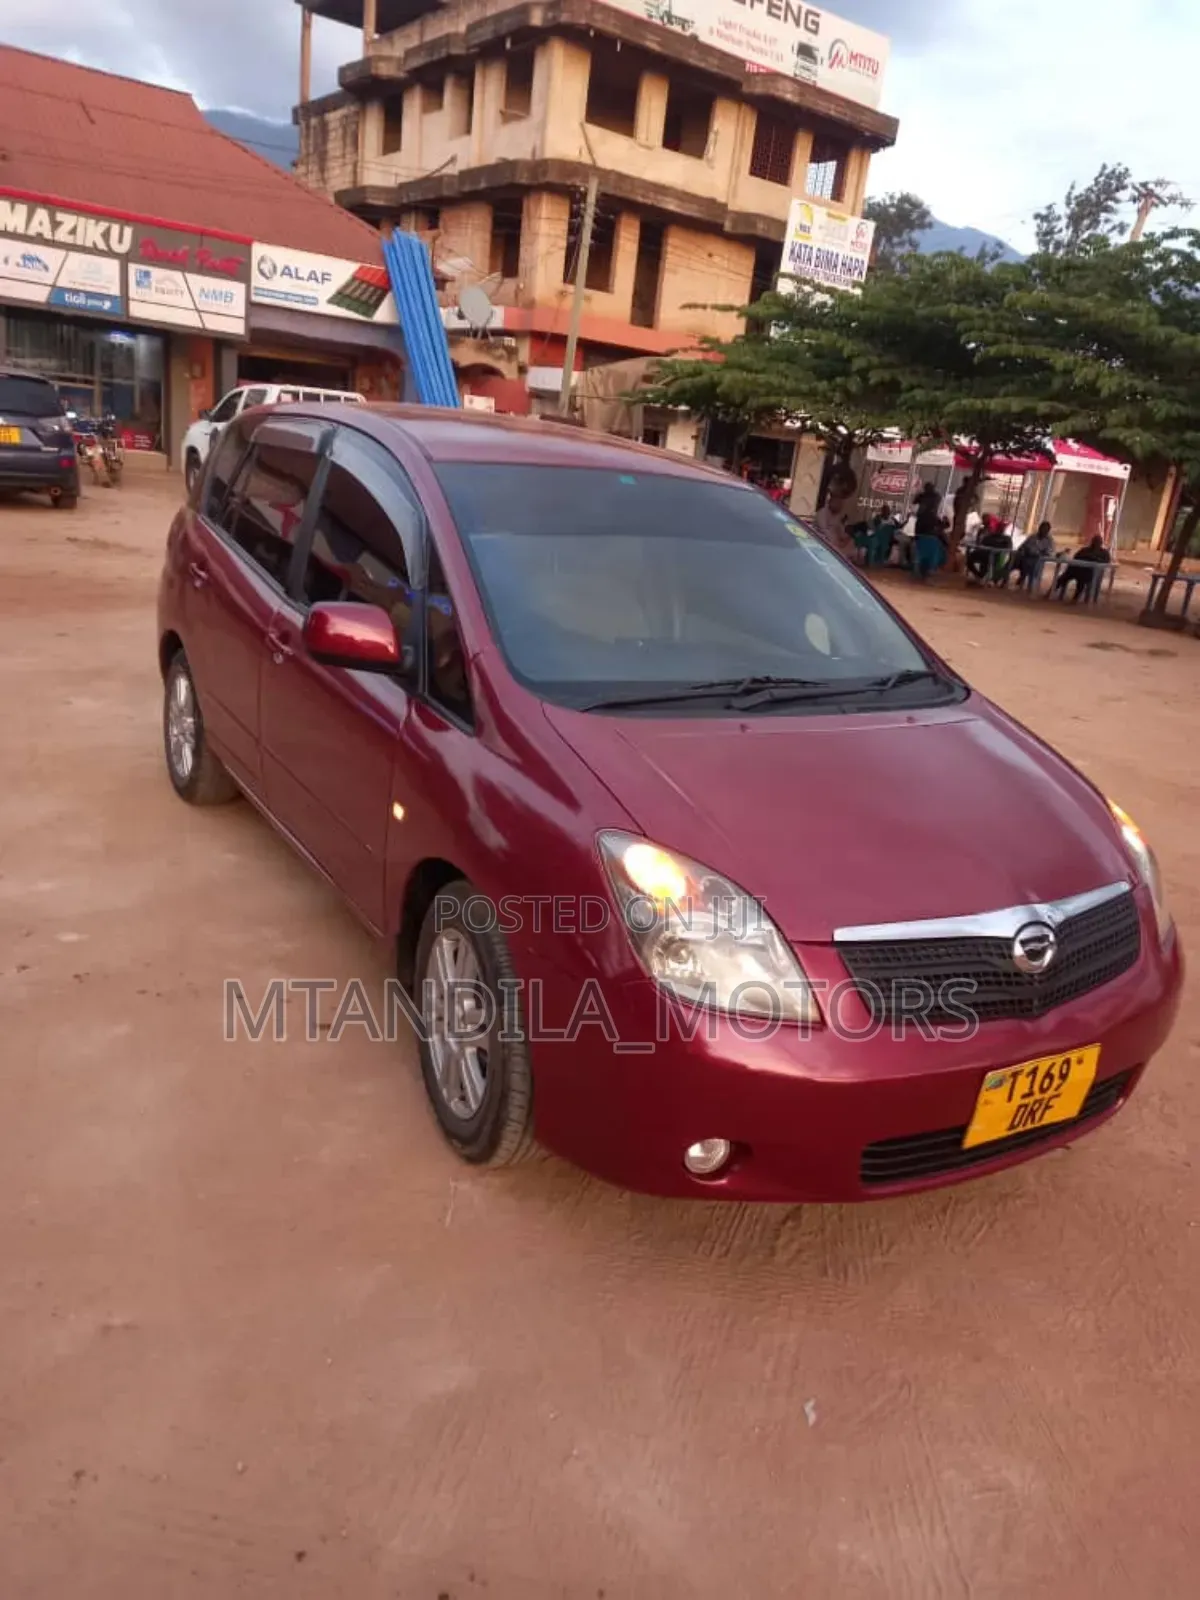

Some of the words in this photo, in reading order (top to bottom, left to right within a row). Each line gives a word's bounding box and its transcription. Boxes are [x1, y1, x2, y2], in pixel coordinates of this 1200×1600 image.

[0, 199, 133, 254] MAZIKU
[279, 263, 332, 286] ALAF
[788, 241, 813, 267] KATA
[814, 248, 840, 274] BIMA
[840, 255, 865, 279] HAPA
[199, 287, 235, 304] NMB
[1006, 1092, 1063, 1131] DRF
